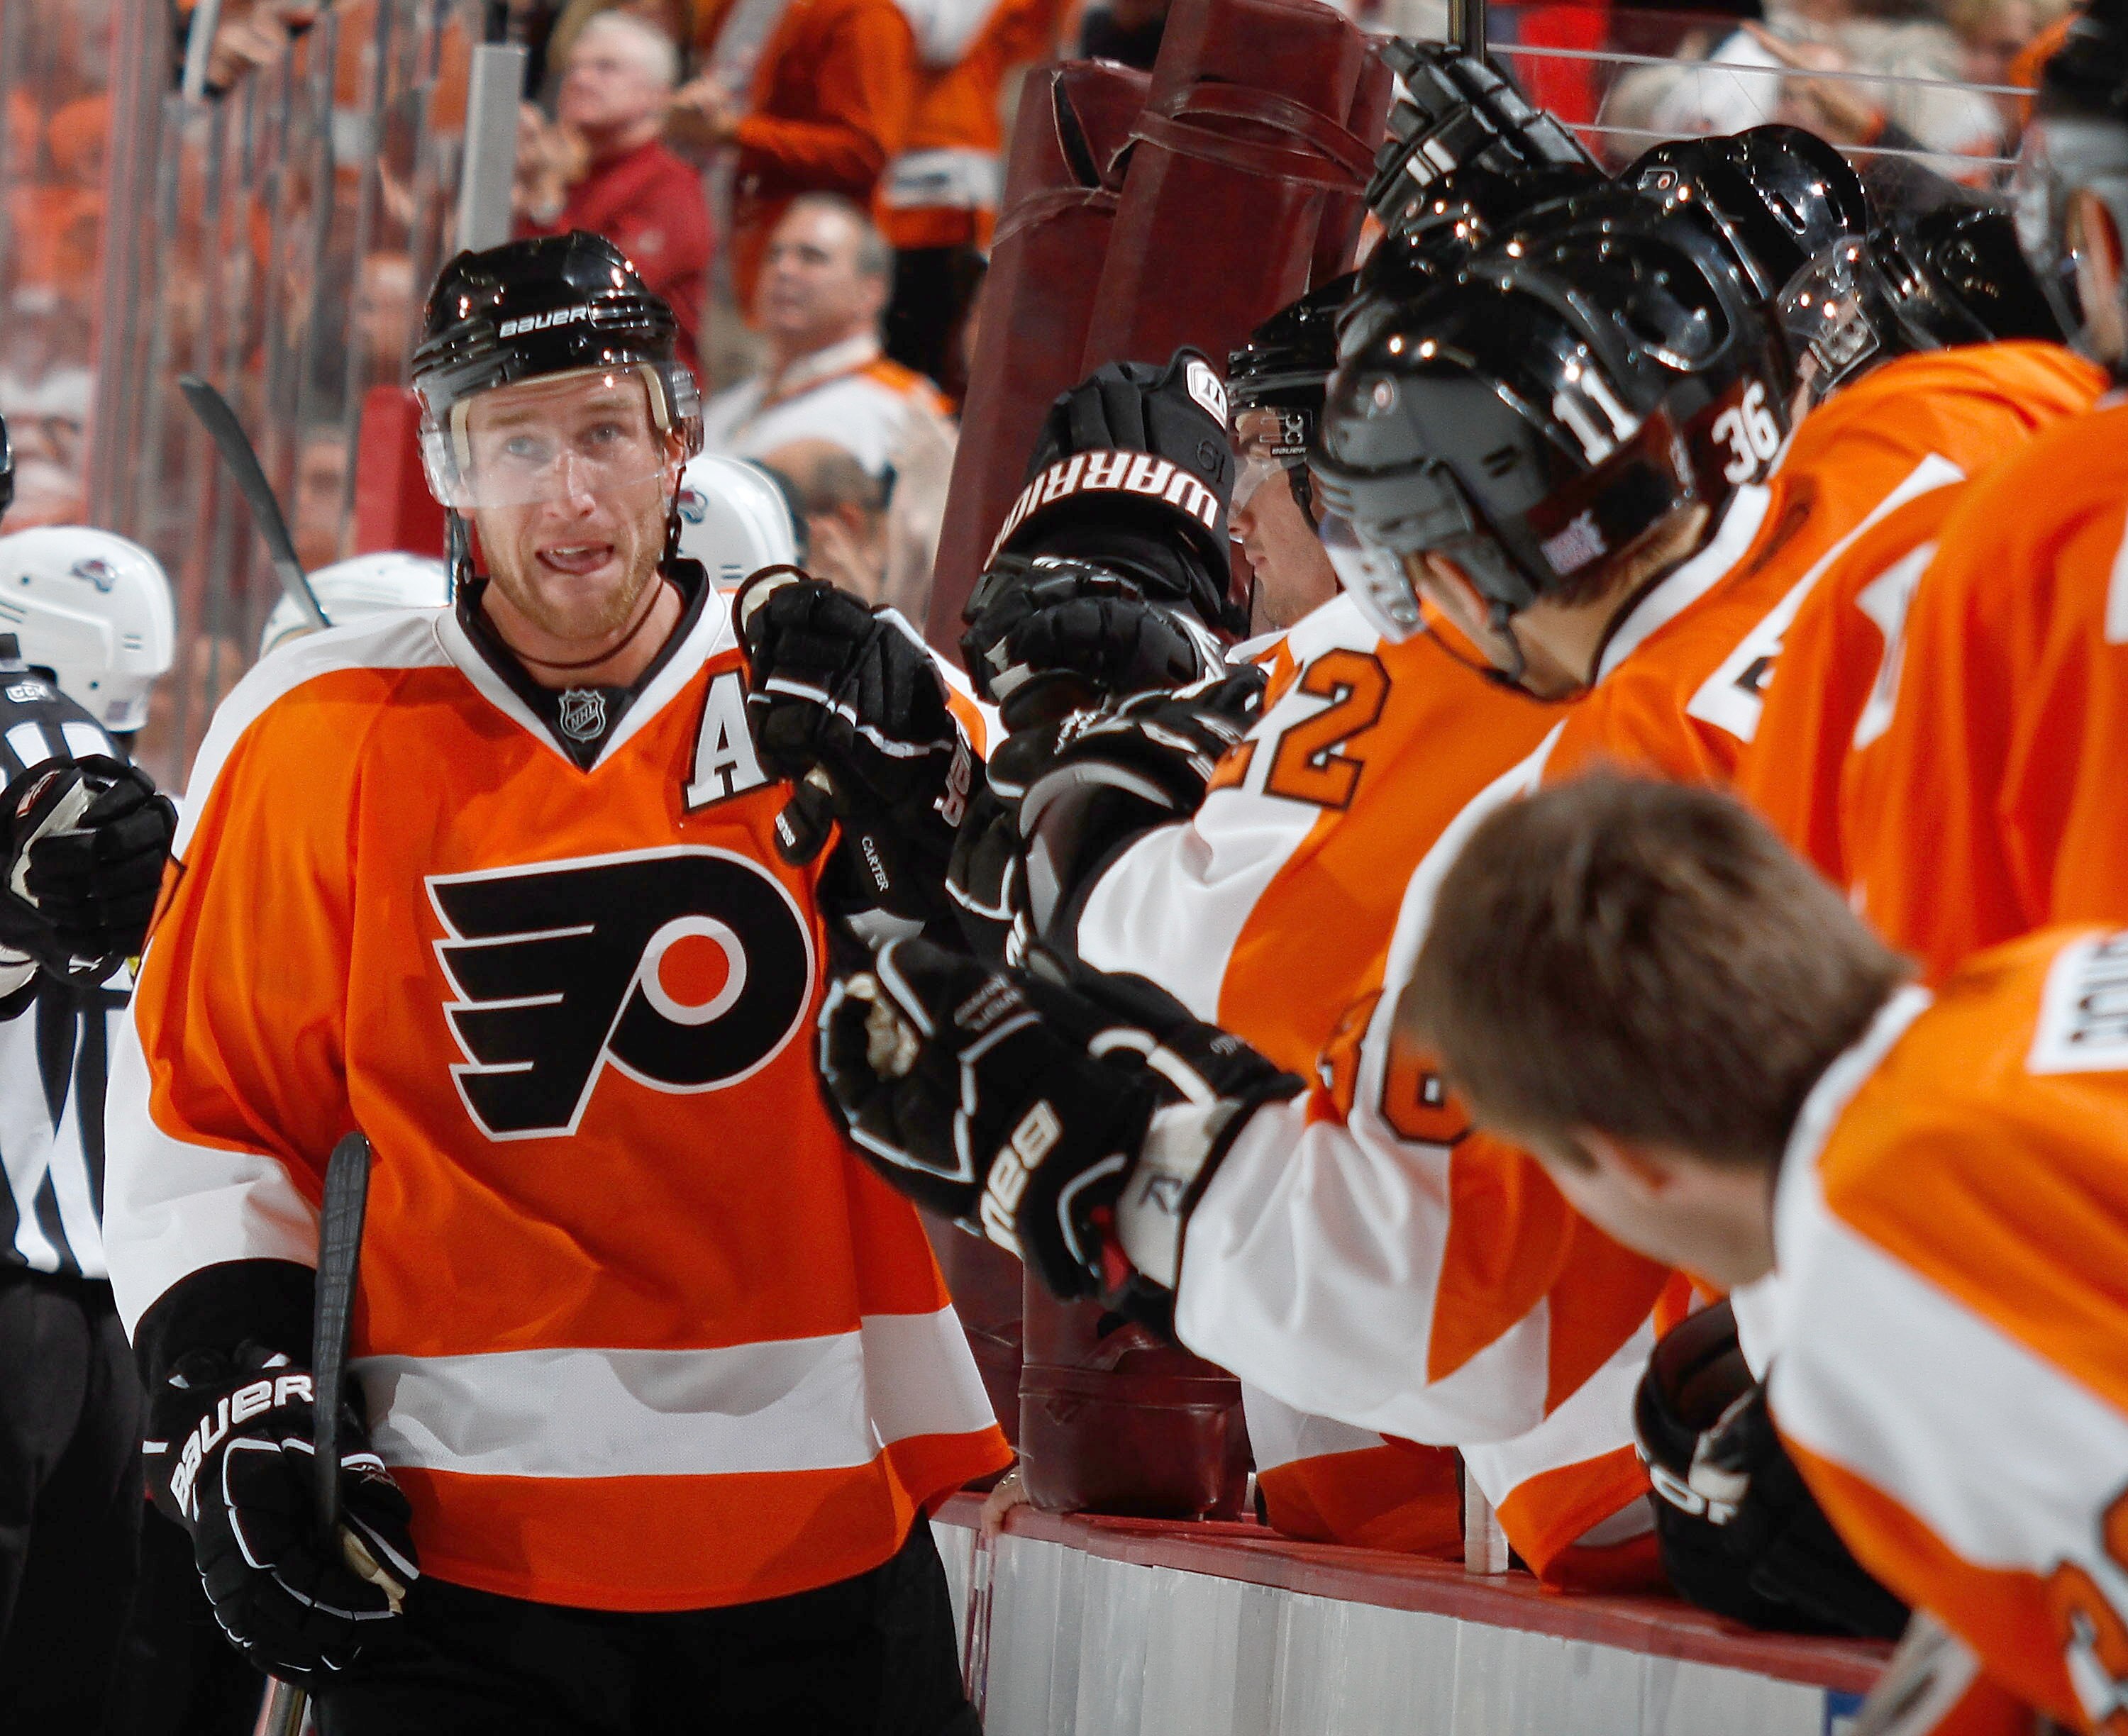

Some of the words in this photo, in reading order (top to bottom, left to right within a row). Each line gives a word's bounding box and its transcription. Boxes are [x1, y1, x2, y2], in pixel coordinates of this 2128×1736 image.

[499, 306, 587, 338] BAUER
[1553, 369, 1640, 467] 11
[1711, 381, 1780, 484] 36
[570, 703, 597, 728] NHL
[682, 670, 775, 813] A
[861, 835, 889, 892] CARTER
[980, 1098, 1063, 1261] BAU
[170, 1374, 314, 1518] BAUER
